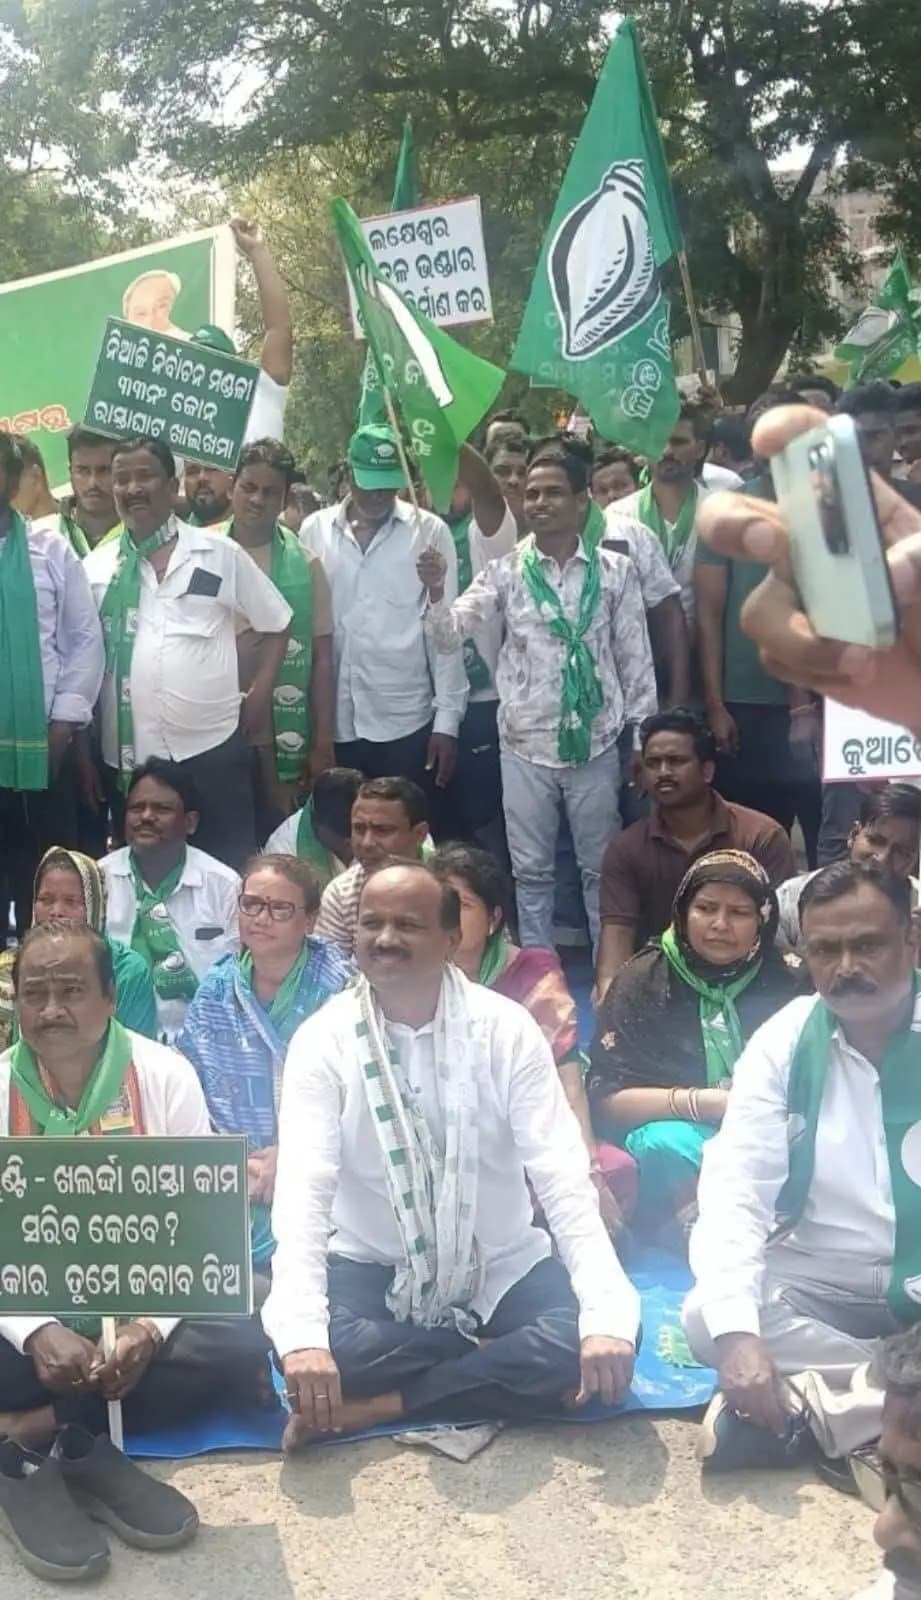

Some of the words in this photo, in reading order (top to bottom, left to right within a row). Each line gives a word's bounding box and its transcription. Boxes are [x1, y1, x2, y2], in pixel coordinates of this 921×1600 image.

[415, 246, 476, 279] ଭଣ୍ଡାର
[455, 287, 487, 313] କର
[106, 328, 150, 368] ନିଆଳି
[151, 343, 206, 387] ନିର୍ବାଚନ
[131, 1164, 185, 1197] ରାସ୍ତା
[193, 1164, 239, 1194] କାମ
[21, 1204, 80, 1245] ସରିବ
[0, 1264, 49, 1296] କାର
[65, 1264, 121, 1304] ତୁମେ
[128, 1264, 194, 1296] ଜବାବ
[202, 1253, 241, 1296] ଦିଅ
